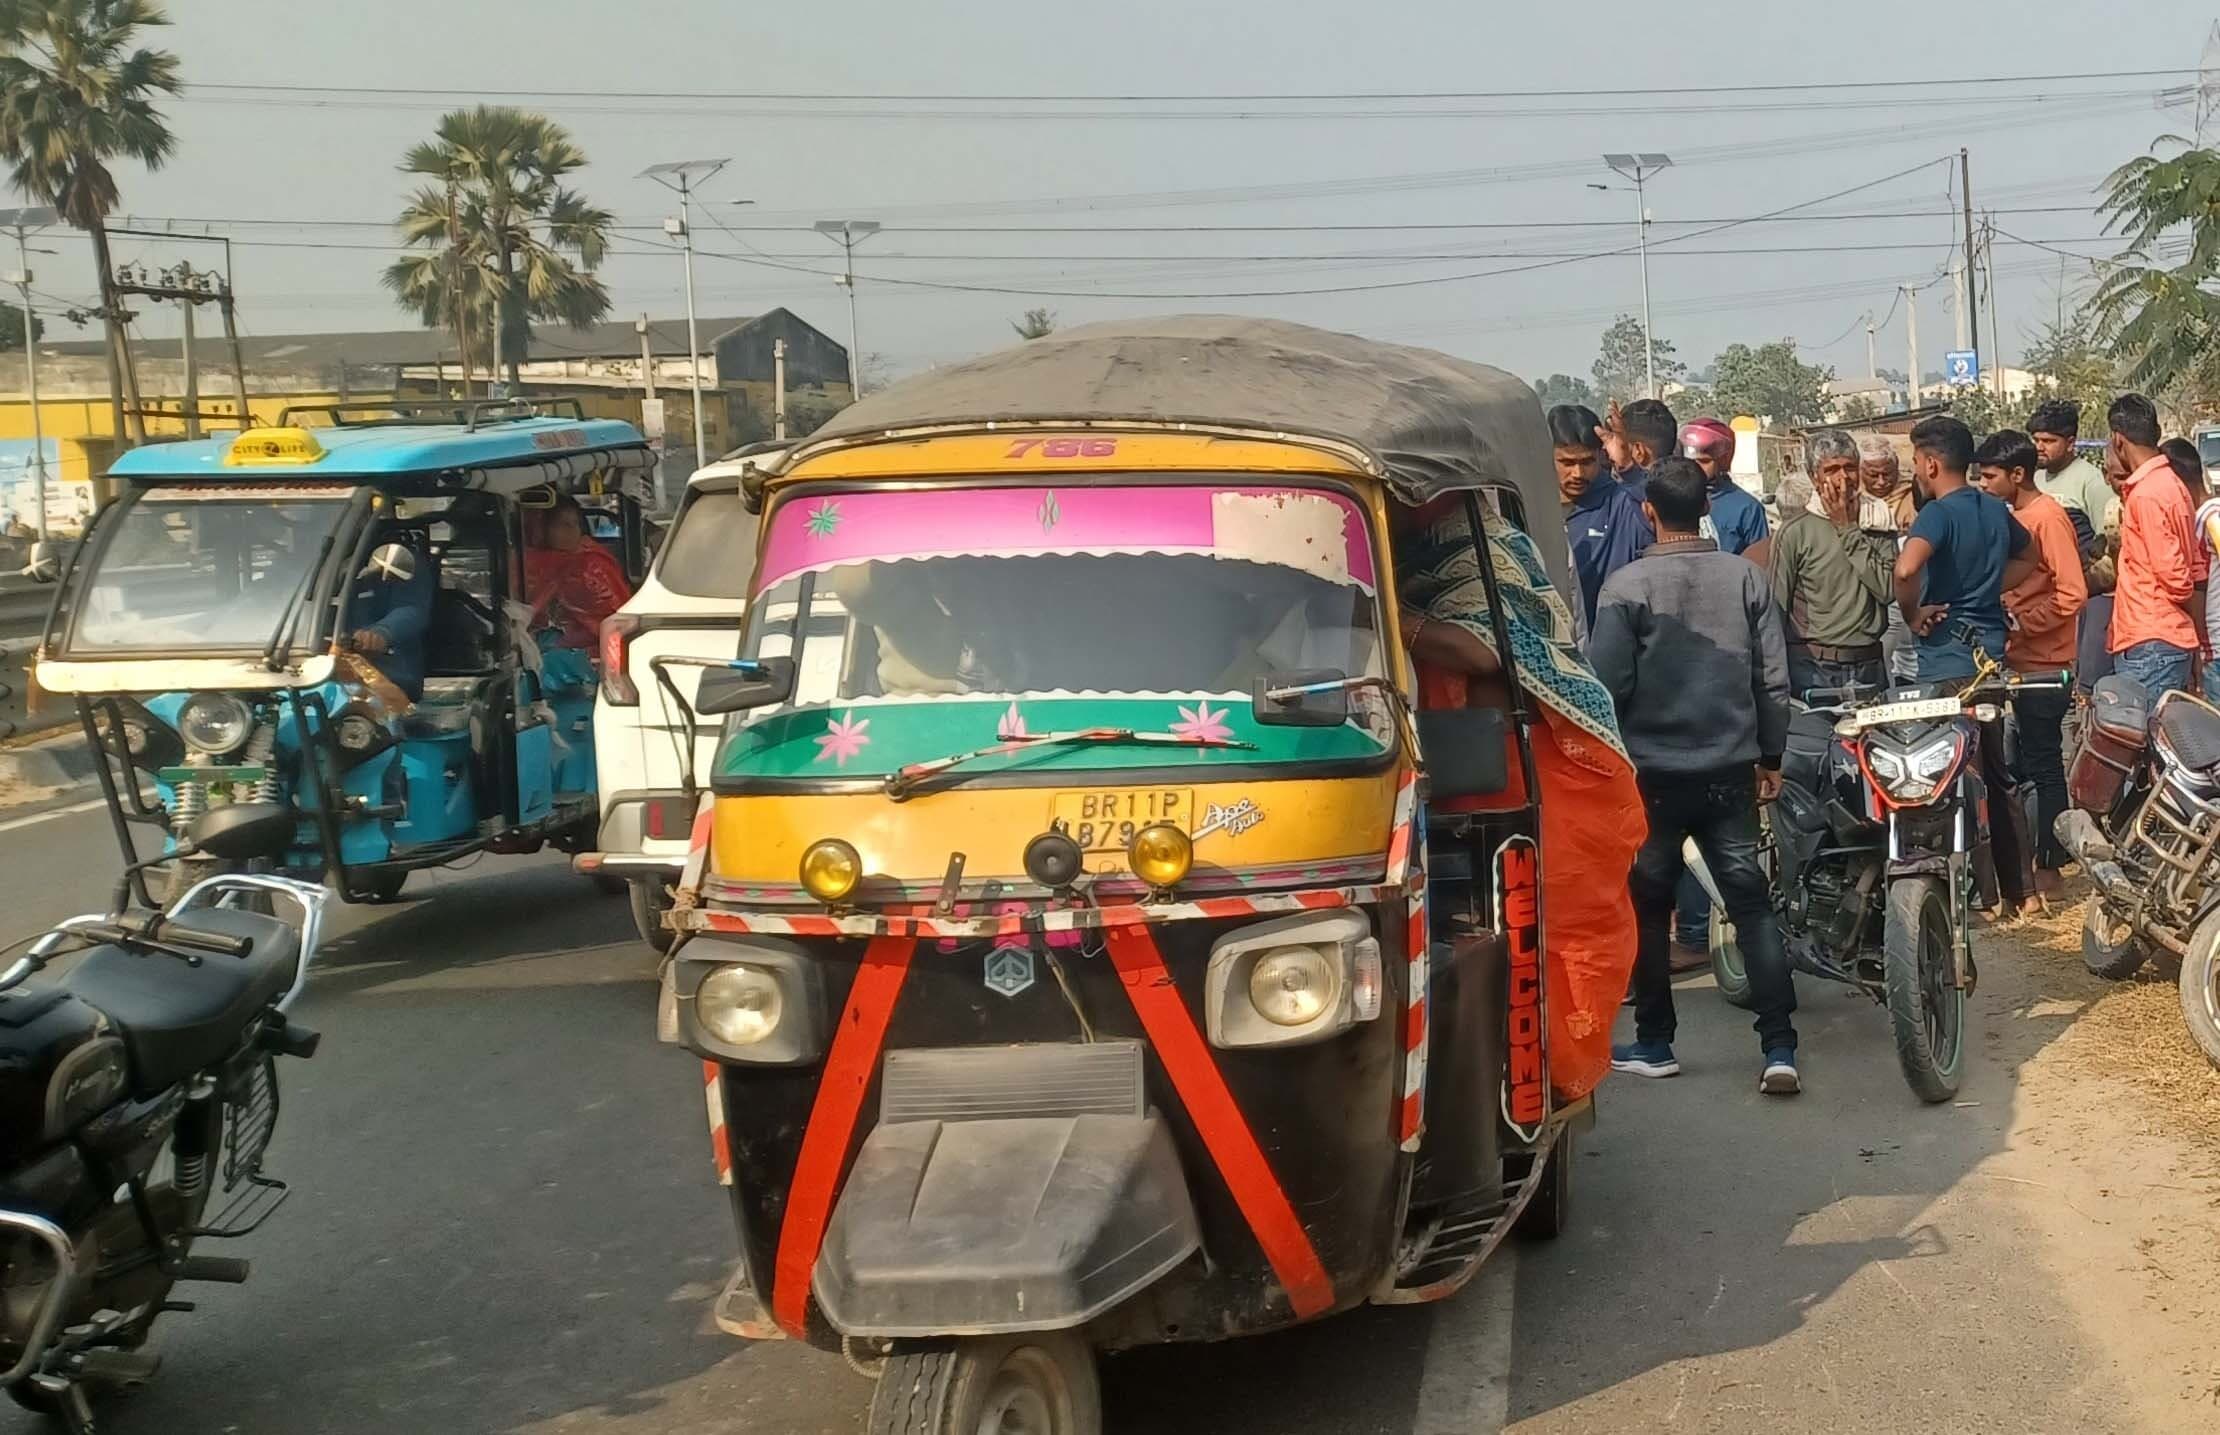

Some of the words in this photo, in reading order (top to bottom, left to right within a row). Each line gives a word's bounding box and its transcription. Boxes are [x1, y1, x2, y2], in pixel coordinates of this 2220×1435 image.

[233, 446, 259, 454] CITY
[1004, 438, 1117, 458] 786
[1082, 792, 1179, 819] BR11P
[1078, 819, 1175, 848] B79
[1503, 847, 1543, 1124] WELCOME
